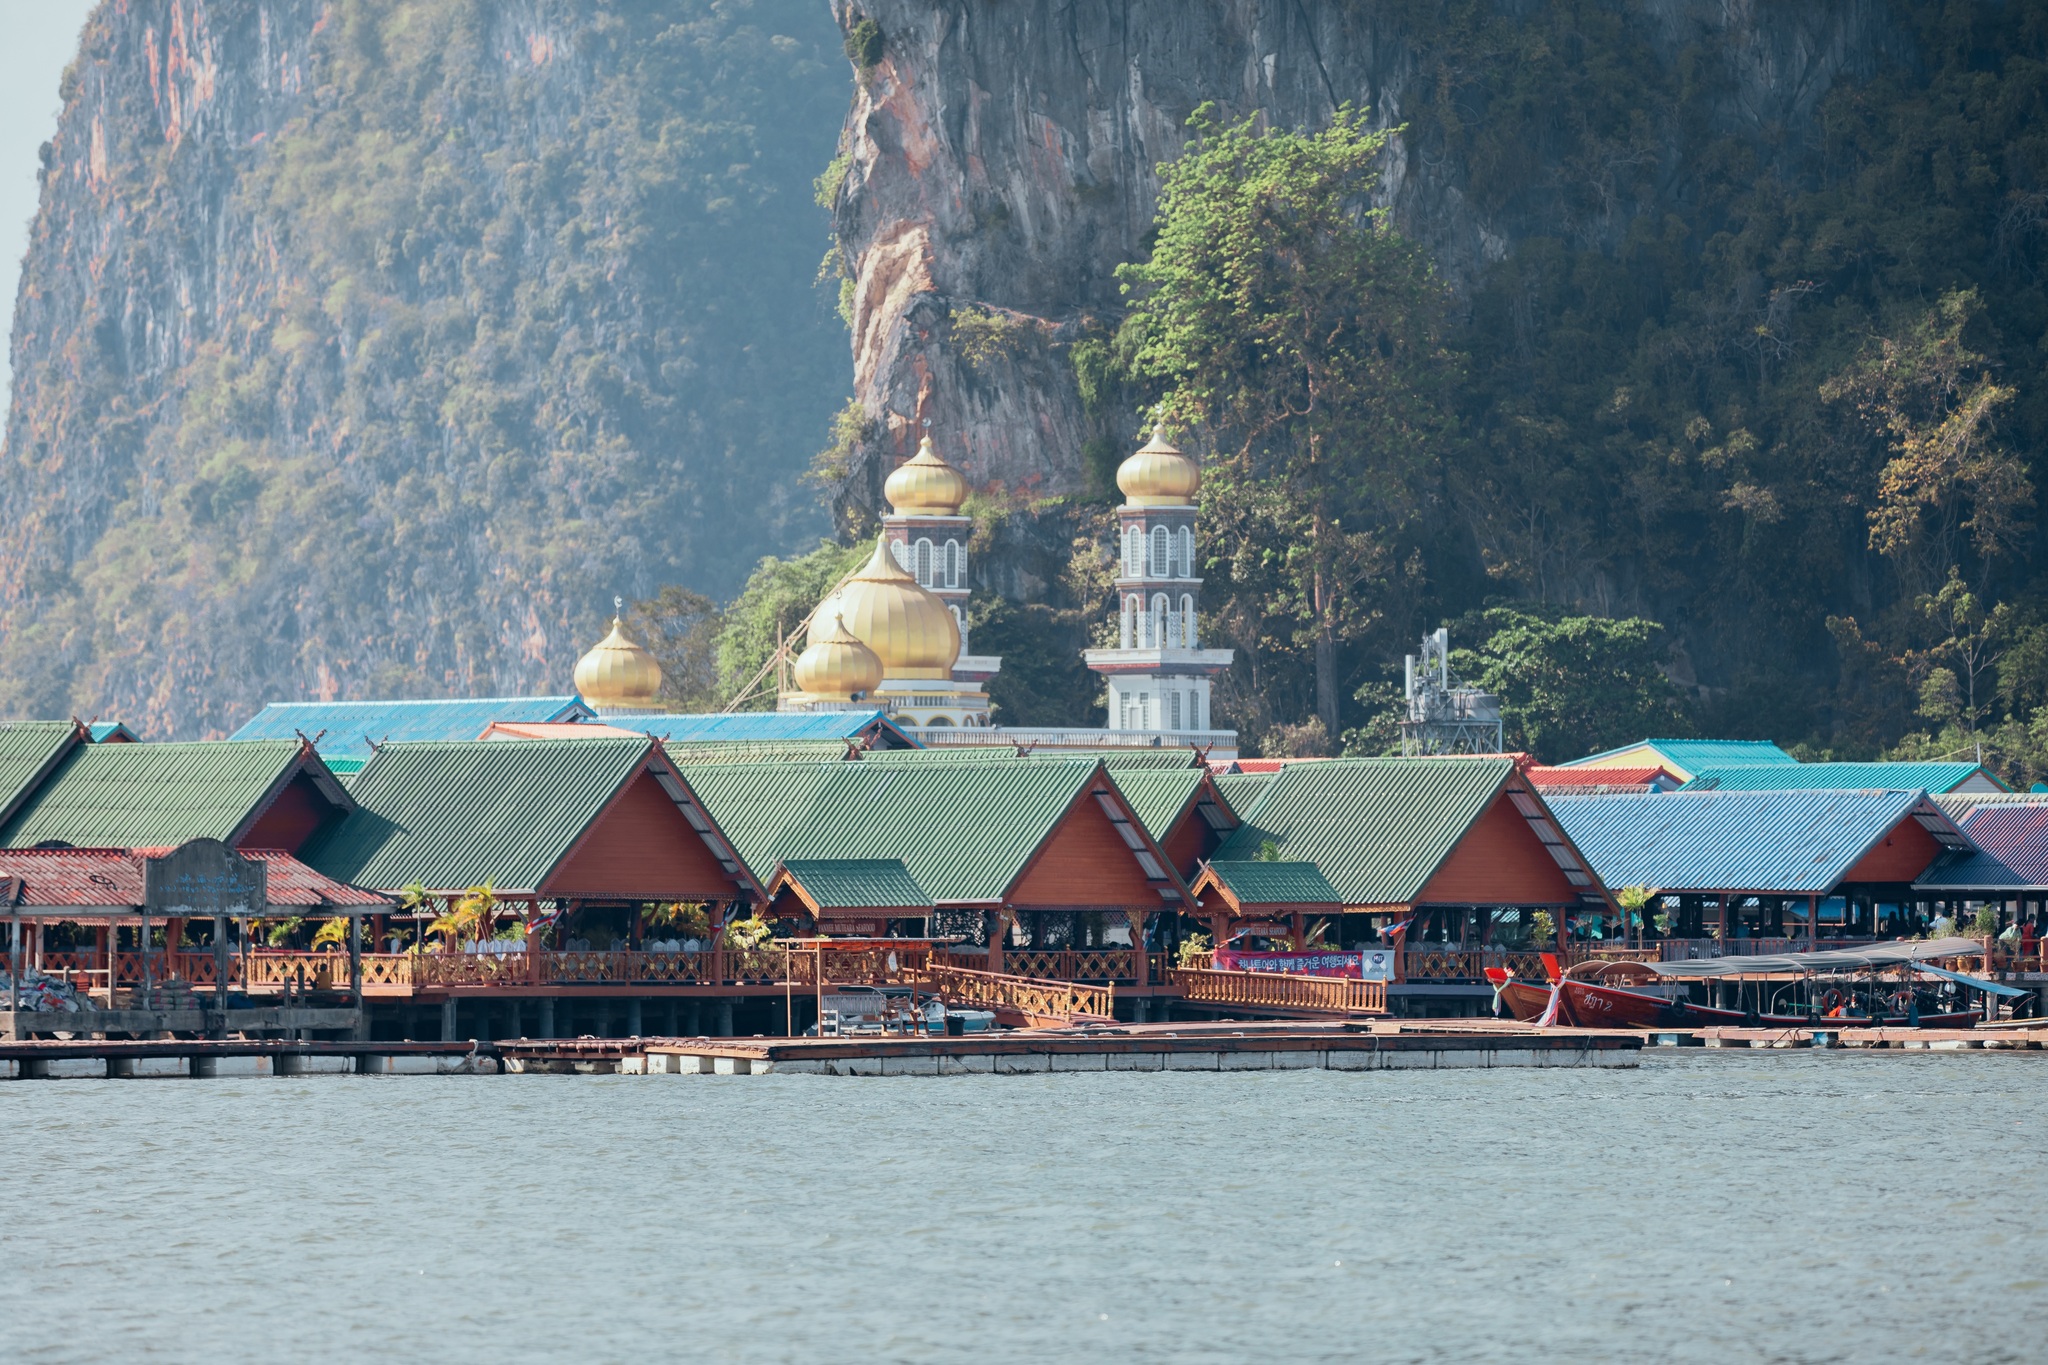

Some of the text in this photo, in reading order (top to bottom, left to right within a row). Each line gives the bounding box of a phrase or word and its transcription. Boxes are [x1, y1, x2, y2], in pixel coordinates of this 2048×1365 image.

[856, 923, 876, 932] SEAFOOD
[1297, 956, 1320, 970] 즐거운
[1321, 954, 1360, 968] 여행되세요
[1604, 1000, 1612, 1012] 2
